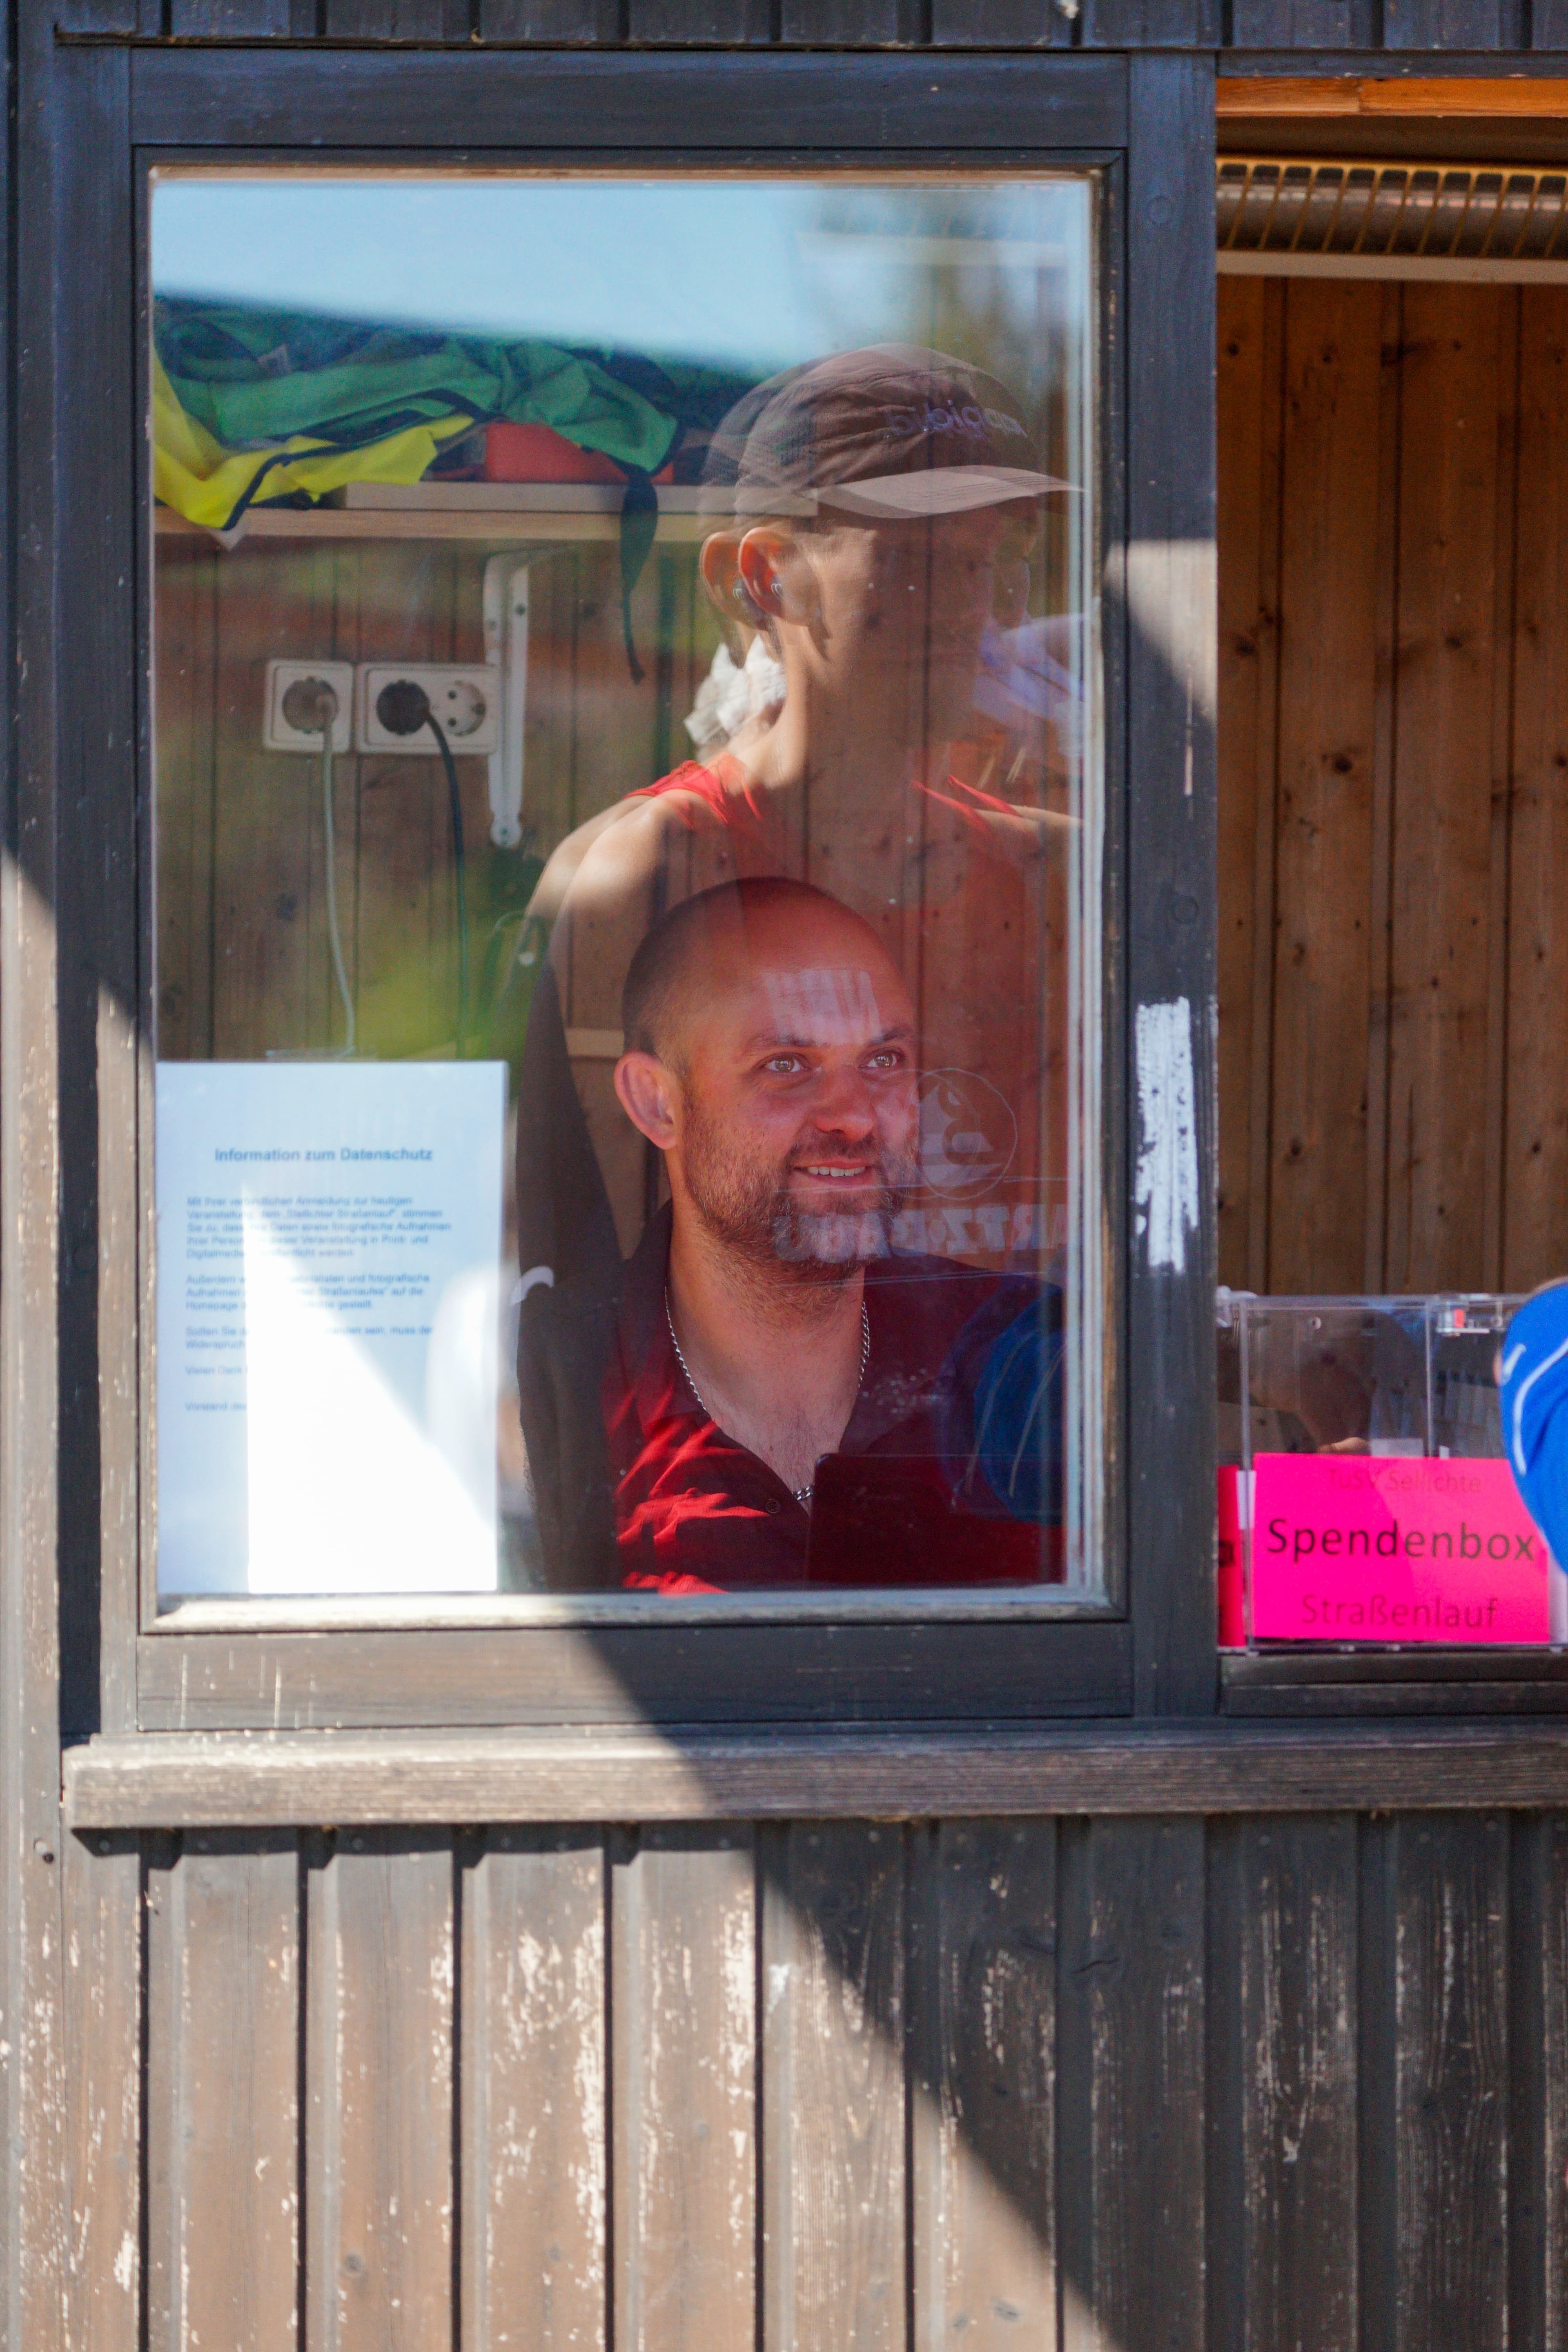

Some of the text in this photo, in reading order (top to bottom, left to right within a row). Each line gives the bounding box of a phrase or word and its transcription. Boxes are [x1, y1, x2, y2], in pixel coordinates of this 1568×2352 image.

[215, 1147, 432, 1162] Information zum Datenschutz
[1267, 1518, 1534, 1563] Spendenbox
[1302, 1594, 1498, 1628] Straßenlauf
